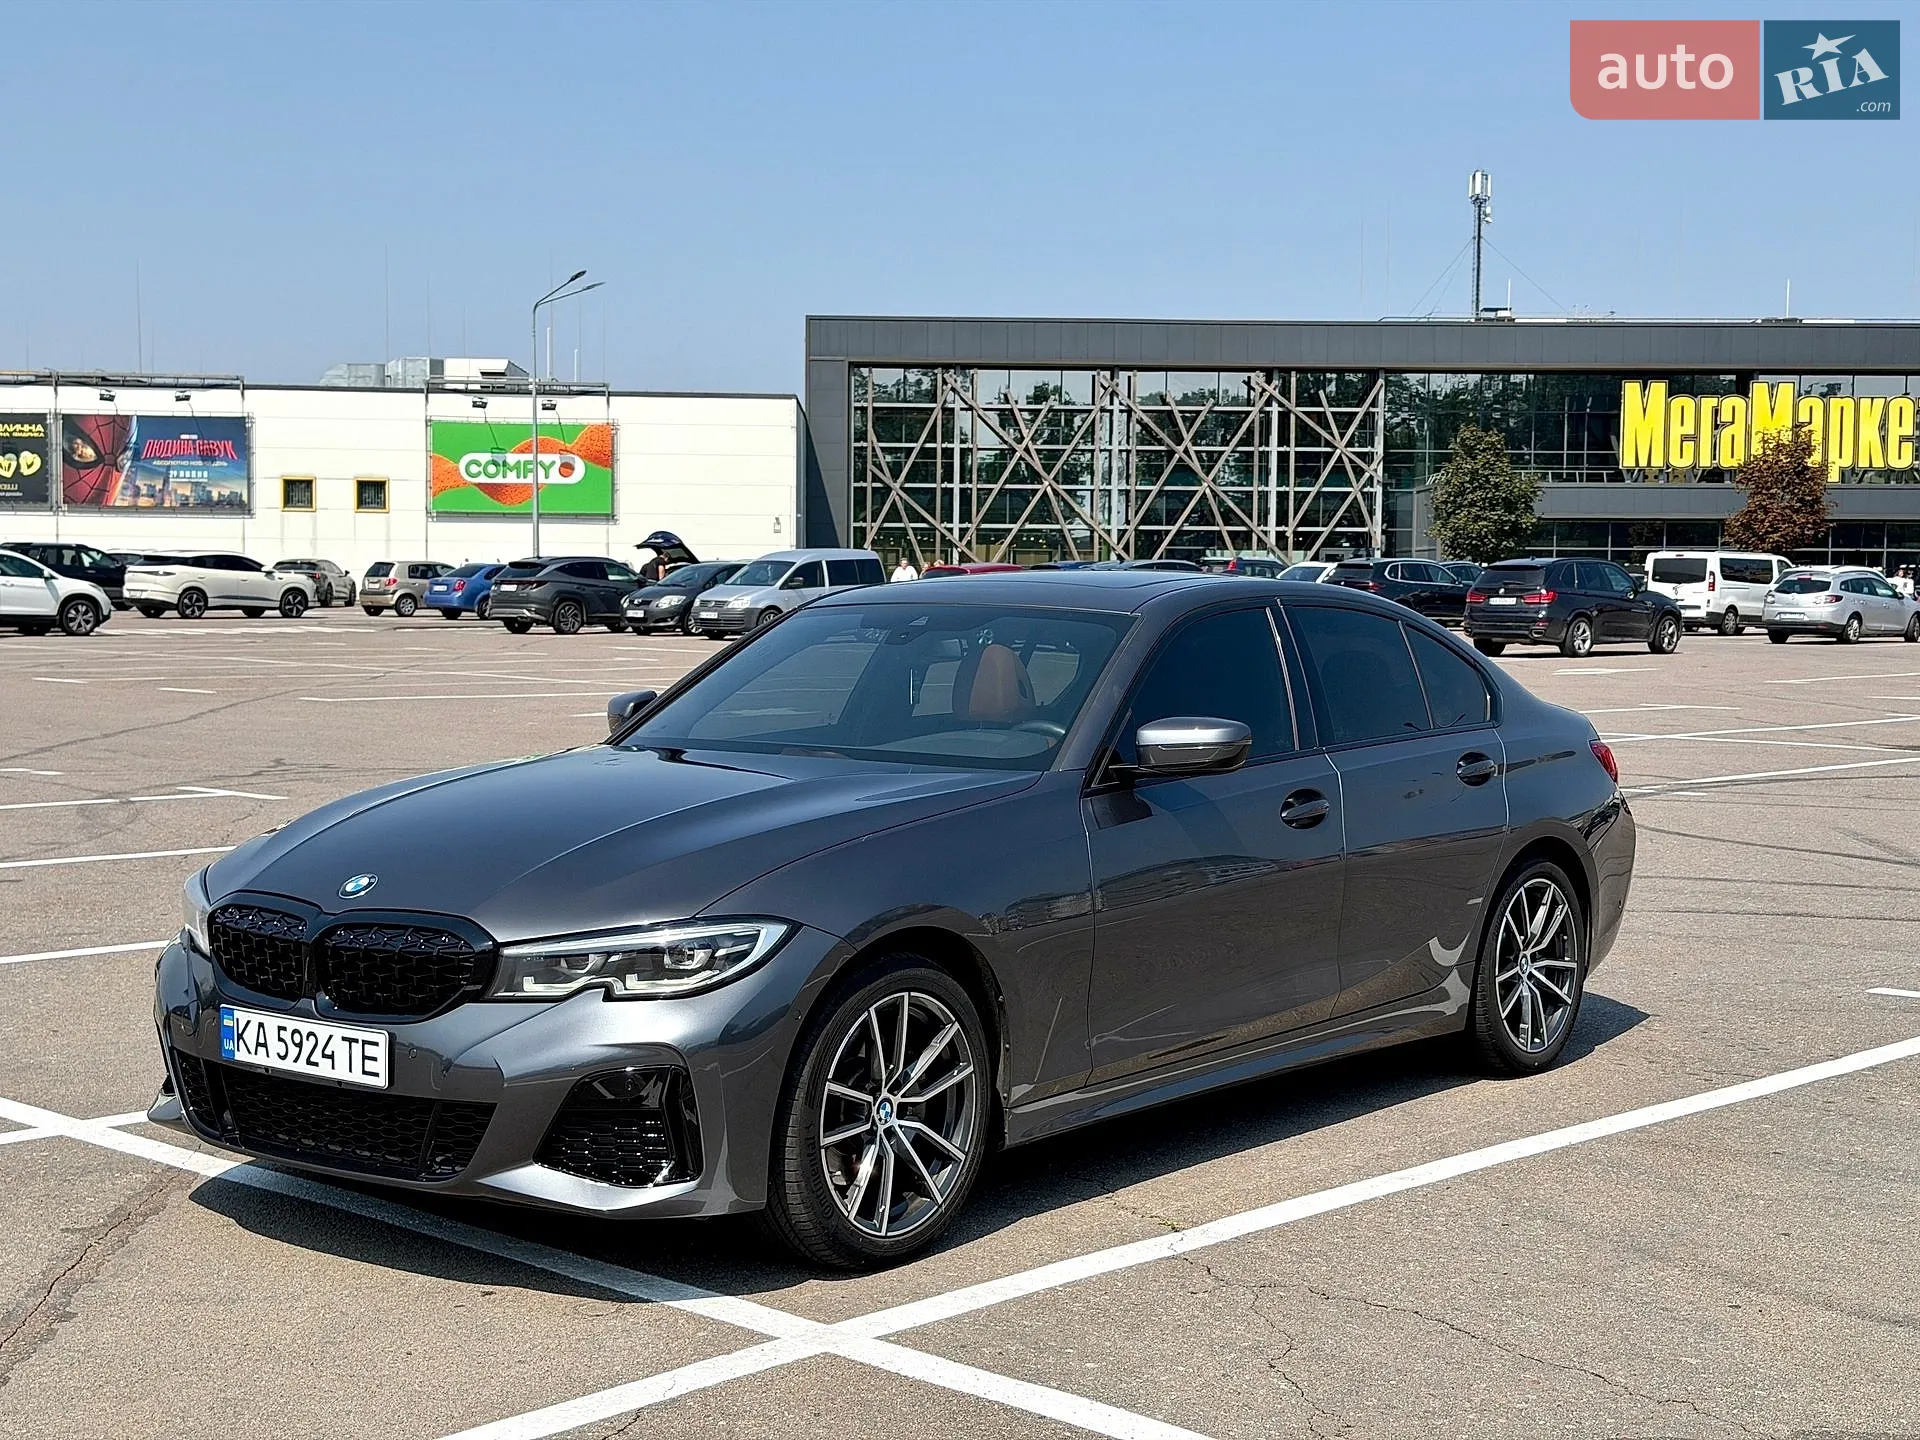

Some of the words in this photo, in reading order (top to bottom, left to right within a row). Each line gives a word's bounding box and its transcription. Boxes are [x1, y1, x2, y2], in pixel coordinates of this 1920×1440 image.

[1619, 379, 1920, 484] МегаМарке
[464, 458, 557, 480] COMFY
[224, 1038, 234, 1050] UA
[235, 1017, 270, 1058] KA
[276, 1025, 336, 1071] 5924
[341, 1035, 381, 1078] TE
